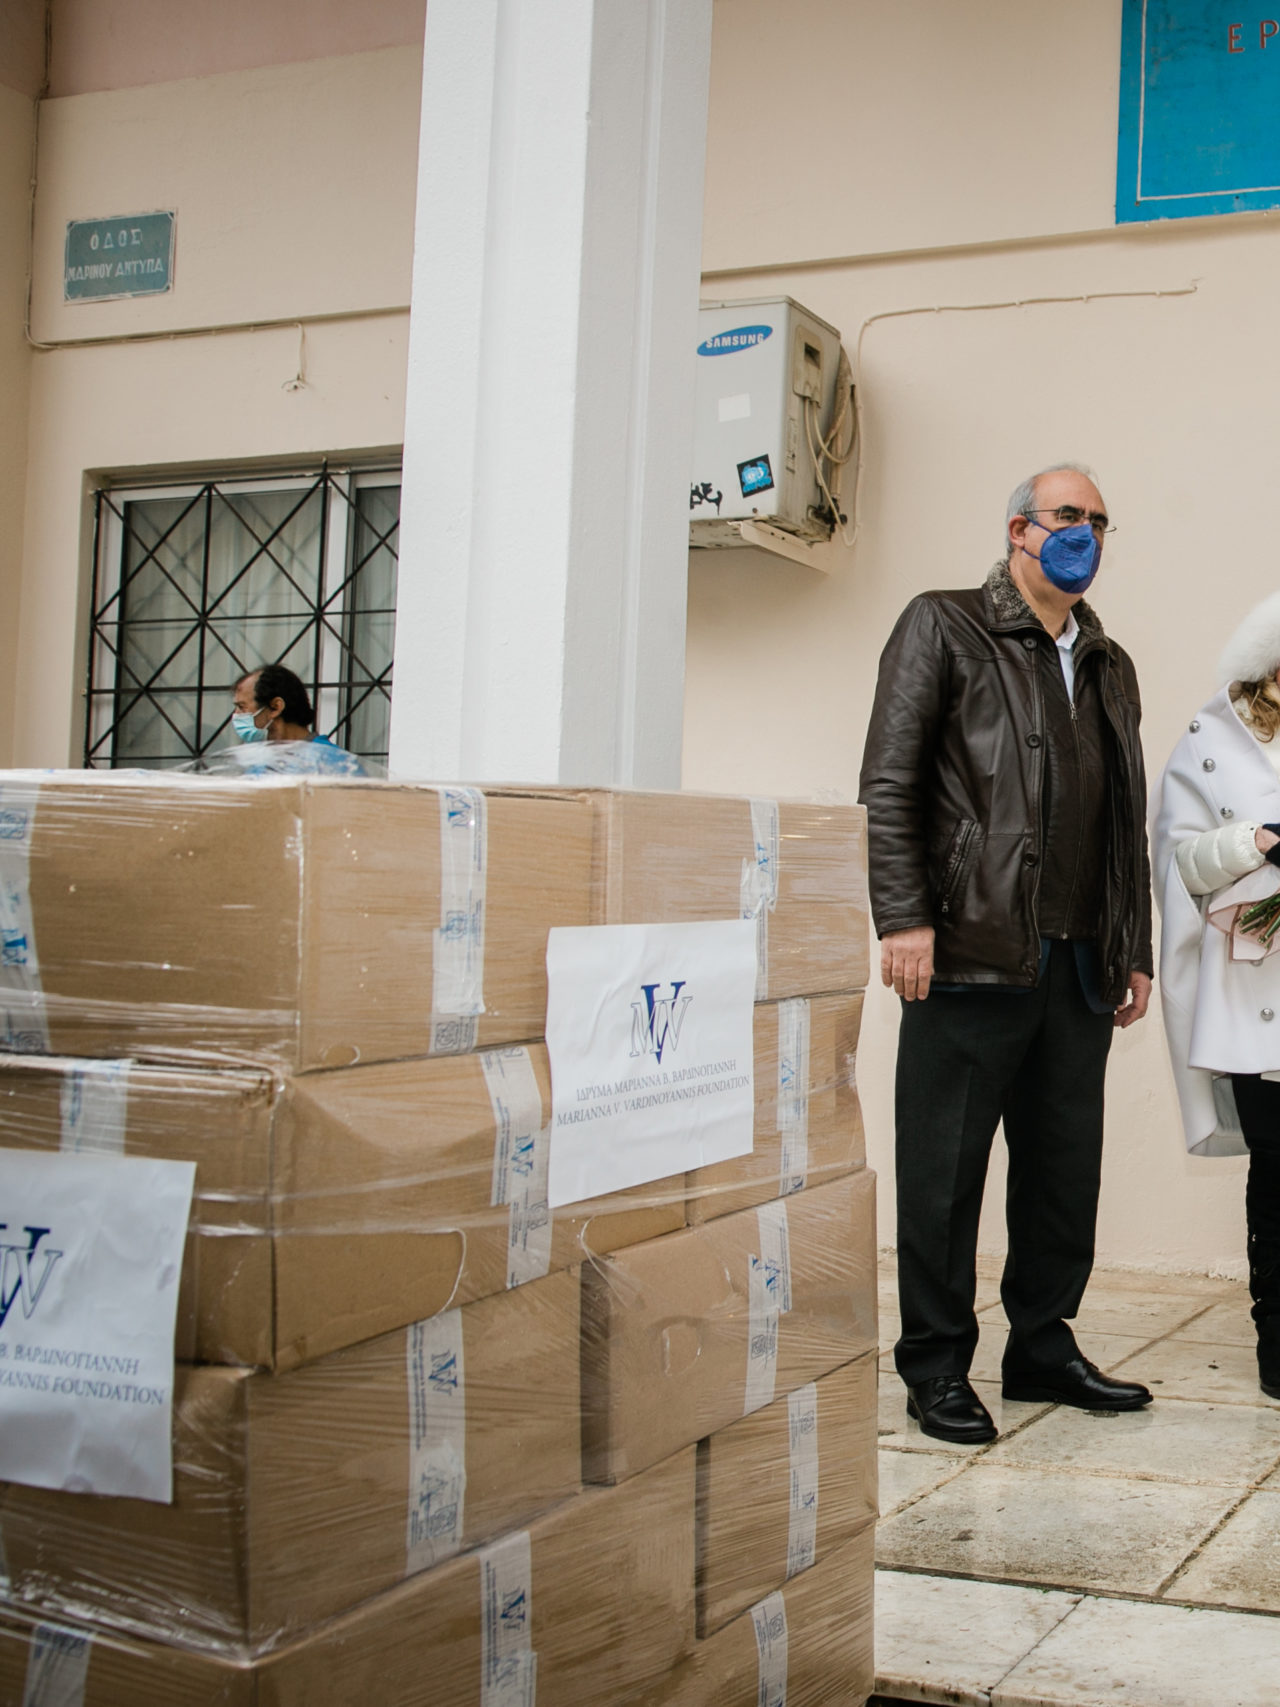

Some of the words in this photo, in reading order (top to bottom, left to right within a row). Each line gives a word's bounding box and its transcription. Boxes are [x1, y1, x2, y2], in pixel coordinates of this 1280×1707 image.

[90, 228, 142, 251] ΟΔΟΣ
[706, 333, 764, 348] SAMSUNG
[556, 1103, 612, 1127] MARIANNA
[695, 1075, 750, 1097] FOUNDATION
[52, 1376, 165, 1406] FOUNDATION
